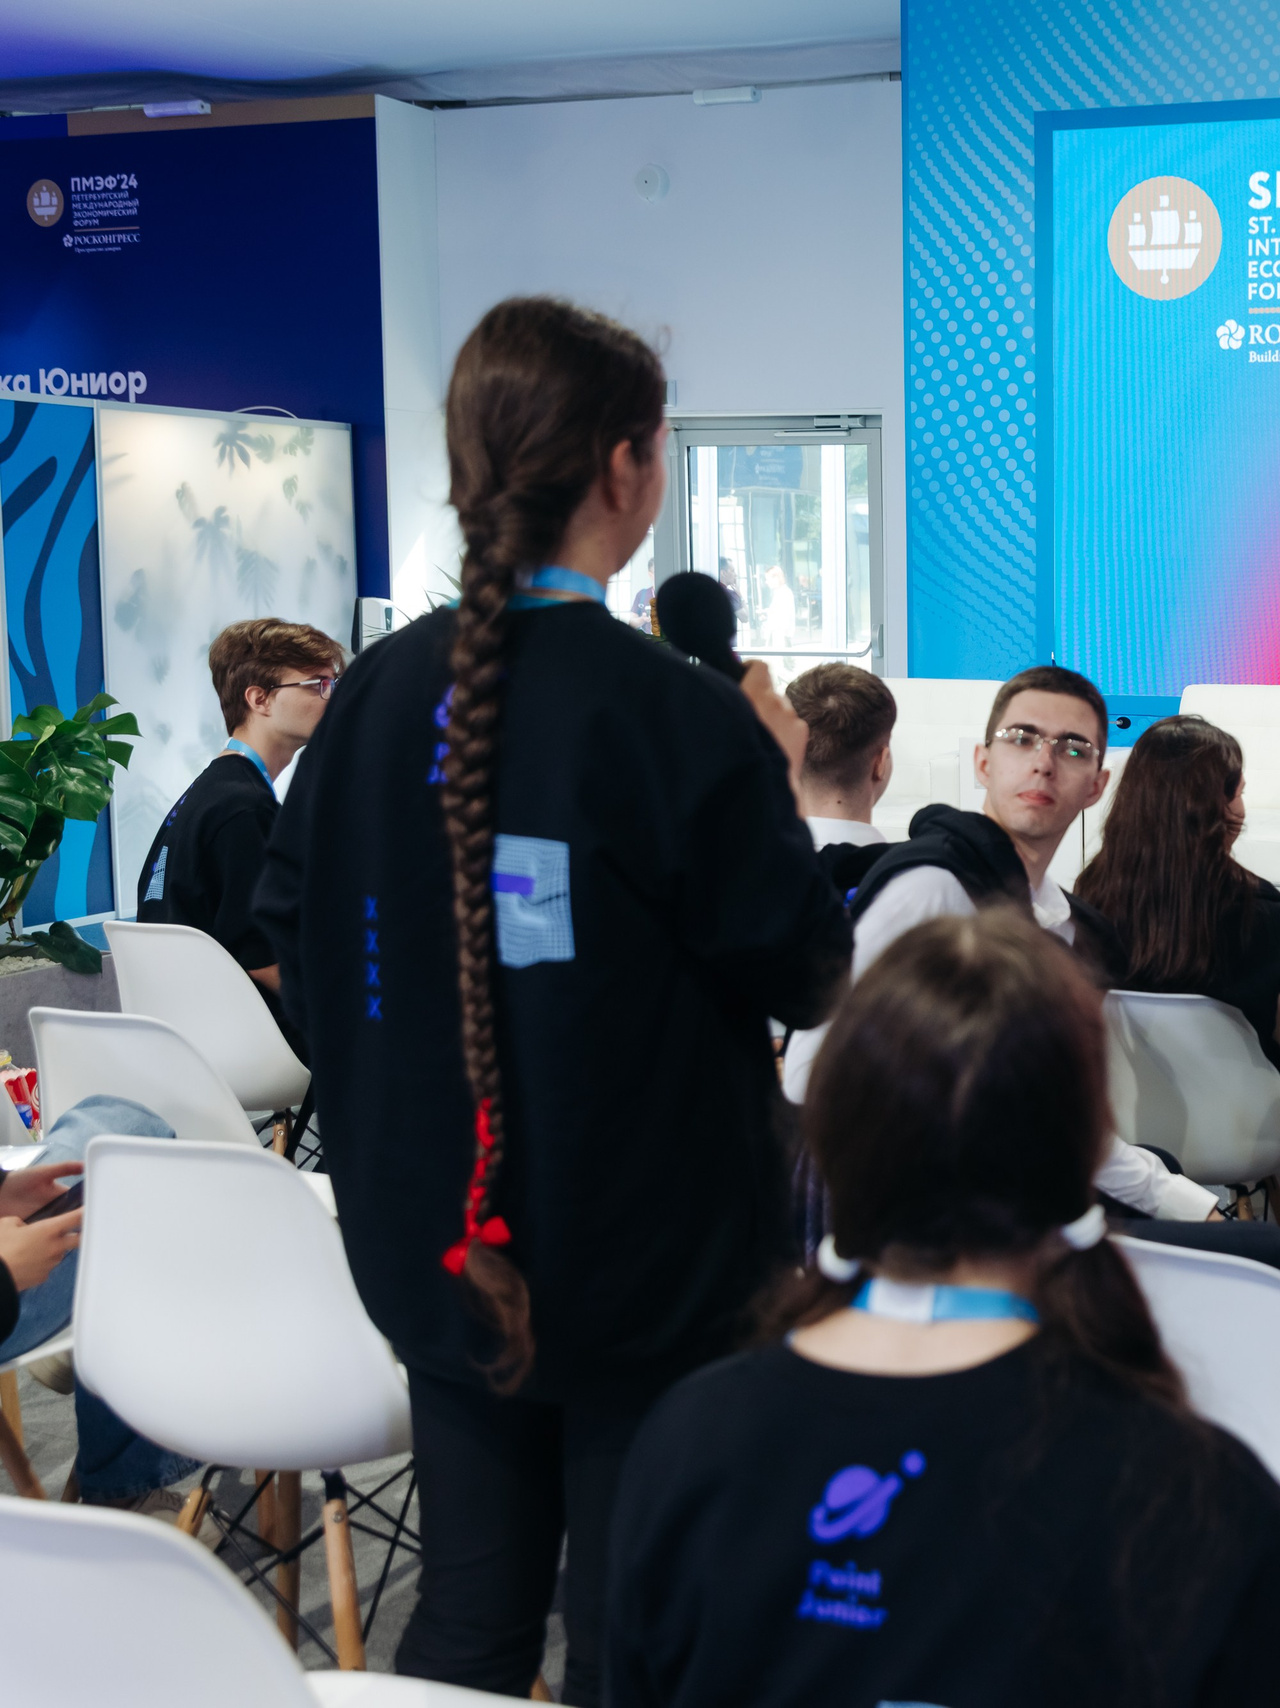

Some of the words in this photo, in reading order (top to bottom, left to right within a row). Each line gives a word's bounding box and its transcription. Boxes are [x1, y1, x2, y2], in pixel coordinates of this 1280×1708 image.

[73, 219, 99, 227] ФОРУМ
[1248, 216, 1275, 234] ST.
[74, 234, 140, 244] РОСКОНГРЕСС
[39, 367, 147, 403] Юниор
